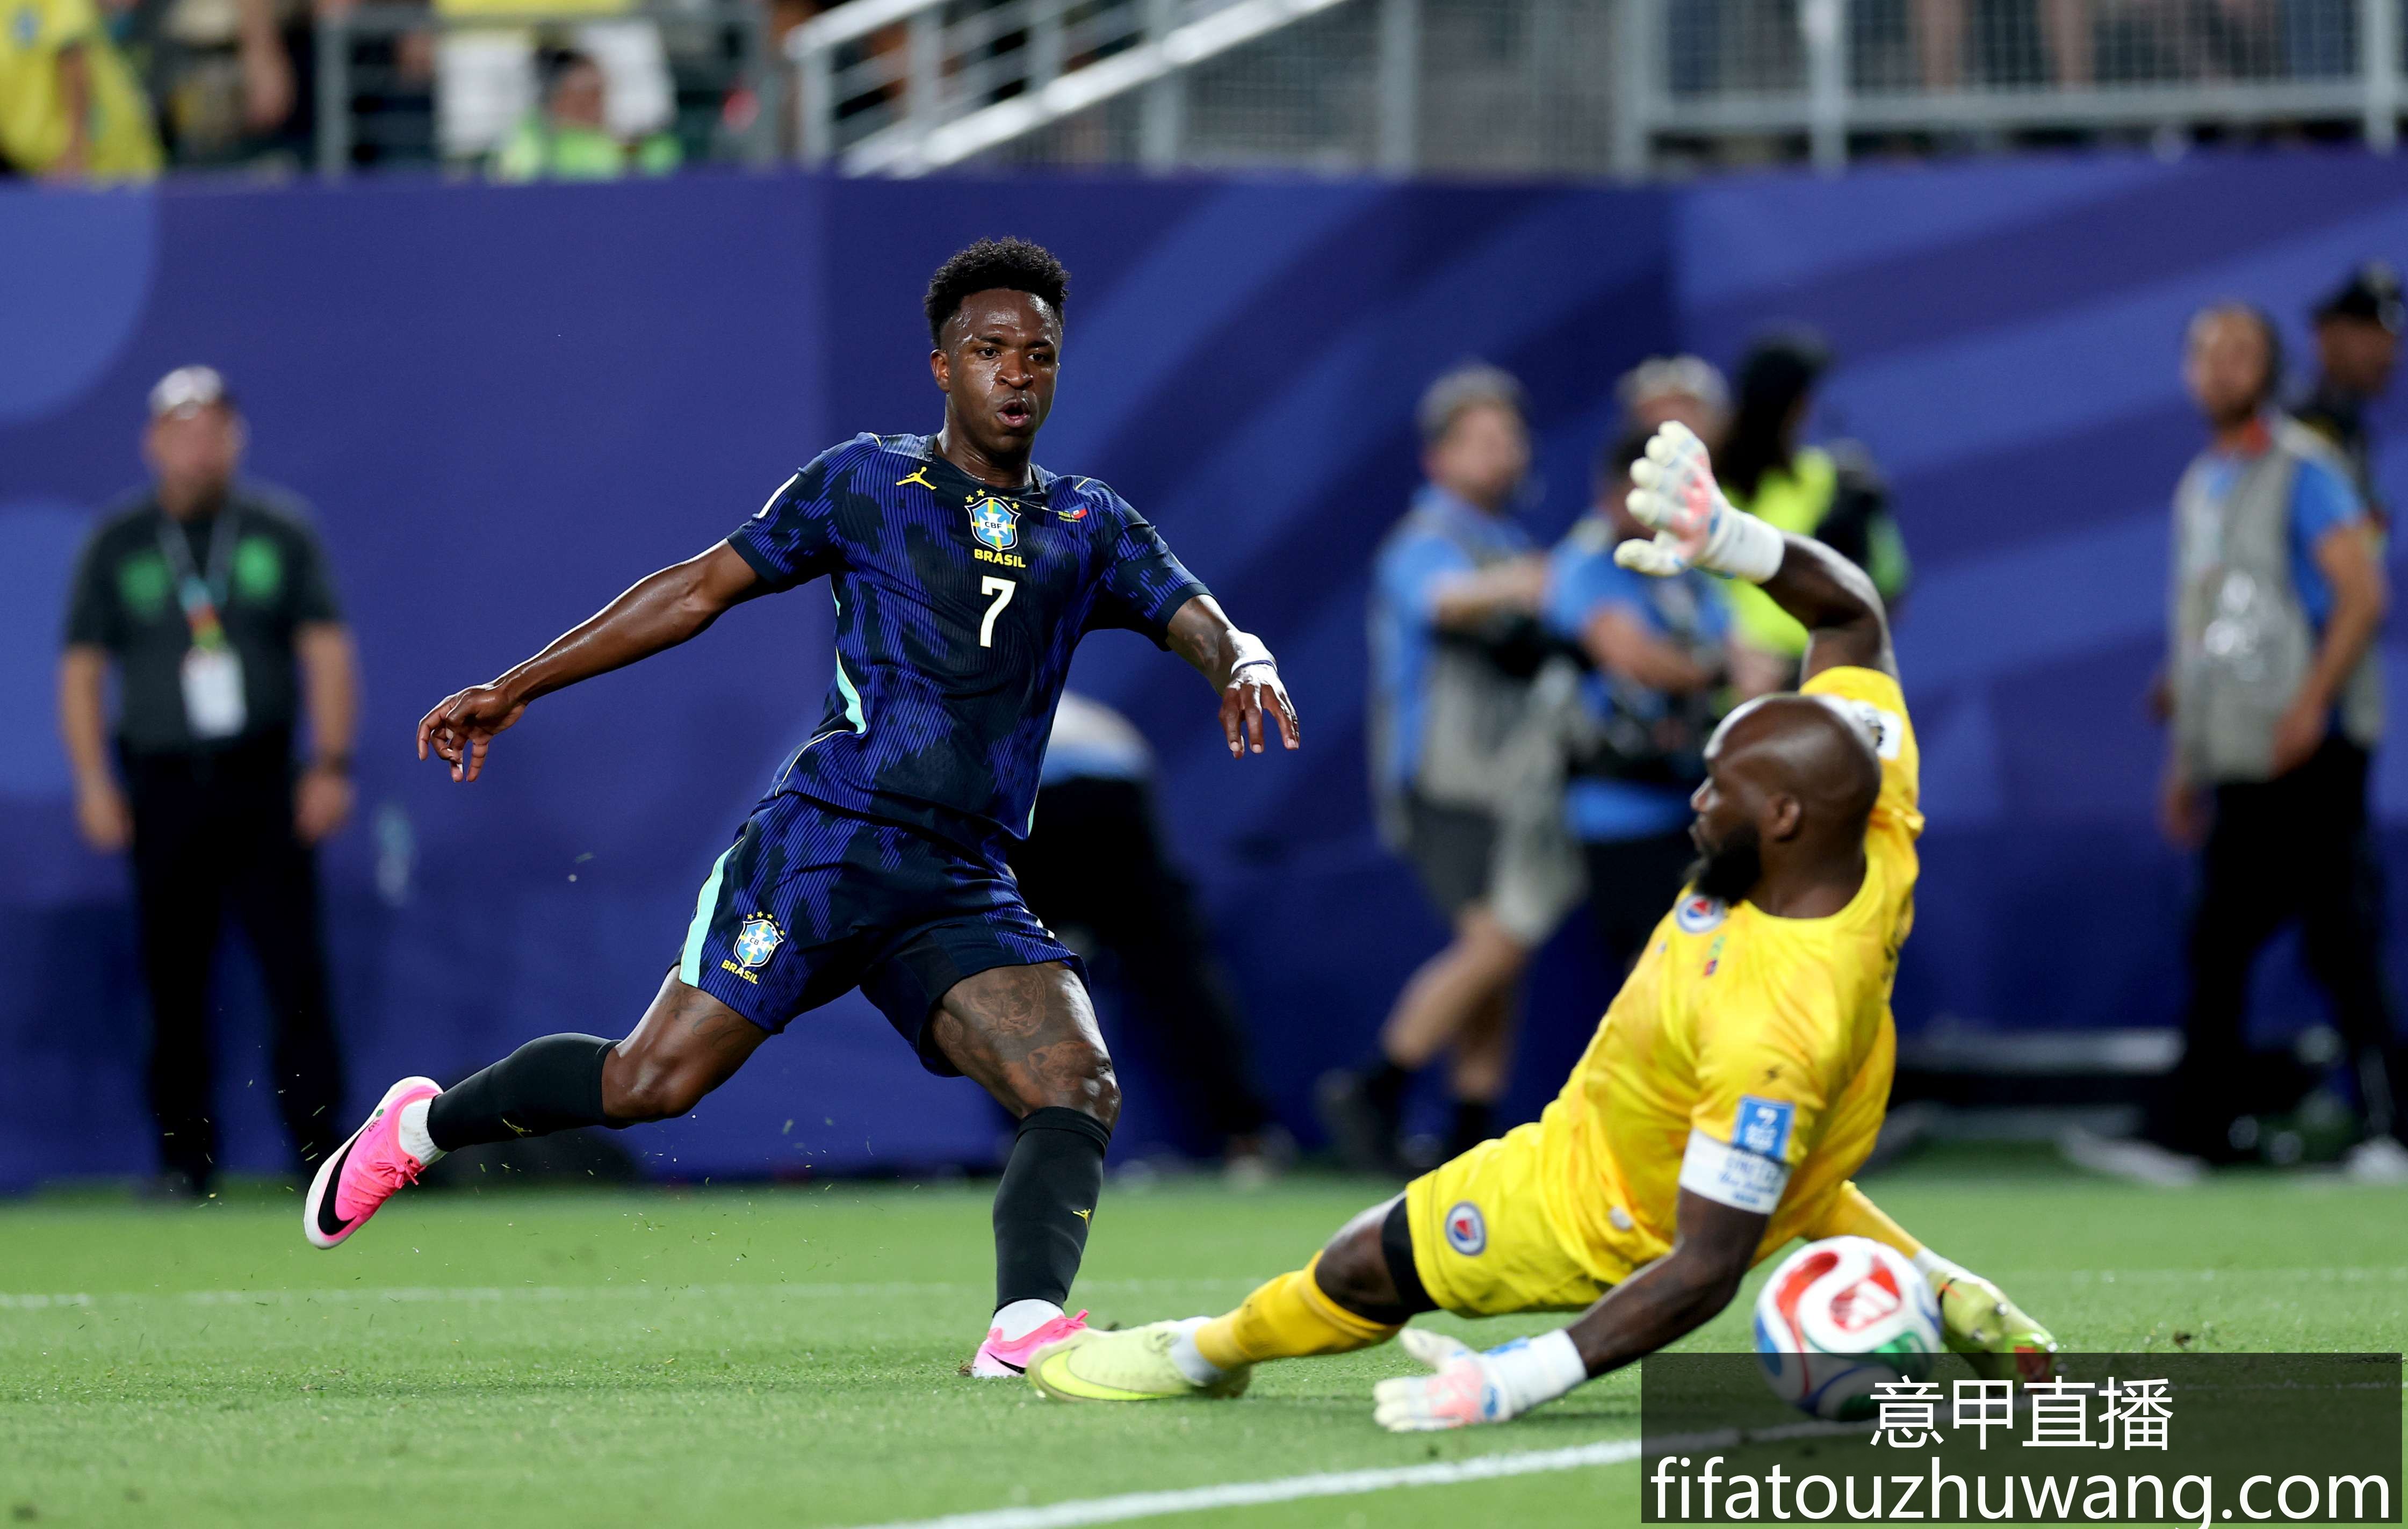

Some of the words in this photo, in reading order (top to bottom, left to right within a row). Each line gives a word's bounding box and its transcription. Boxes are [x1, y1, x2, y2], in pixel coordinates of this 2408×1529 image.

[985, 522, 1002, 530] CBF
[975, 549, 1026, 568] BRASIL
[980, 575, 1016, 647] 7
[722, 960, 758, 984] BRASIL
